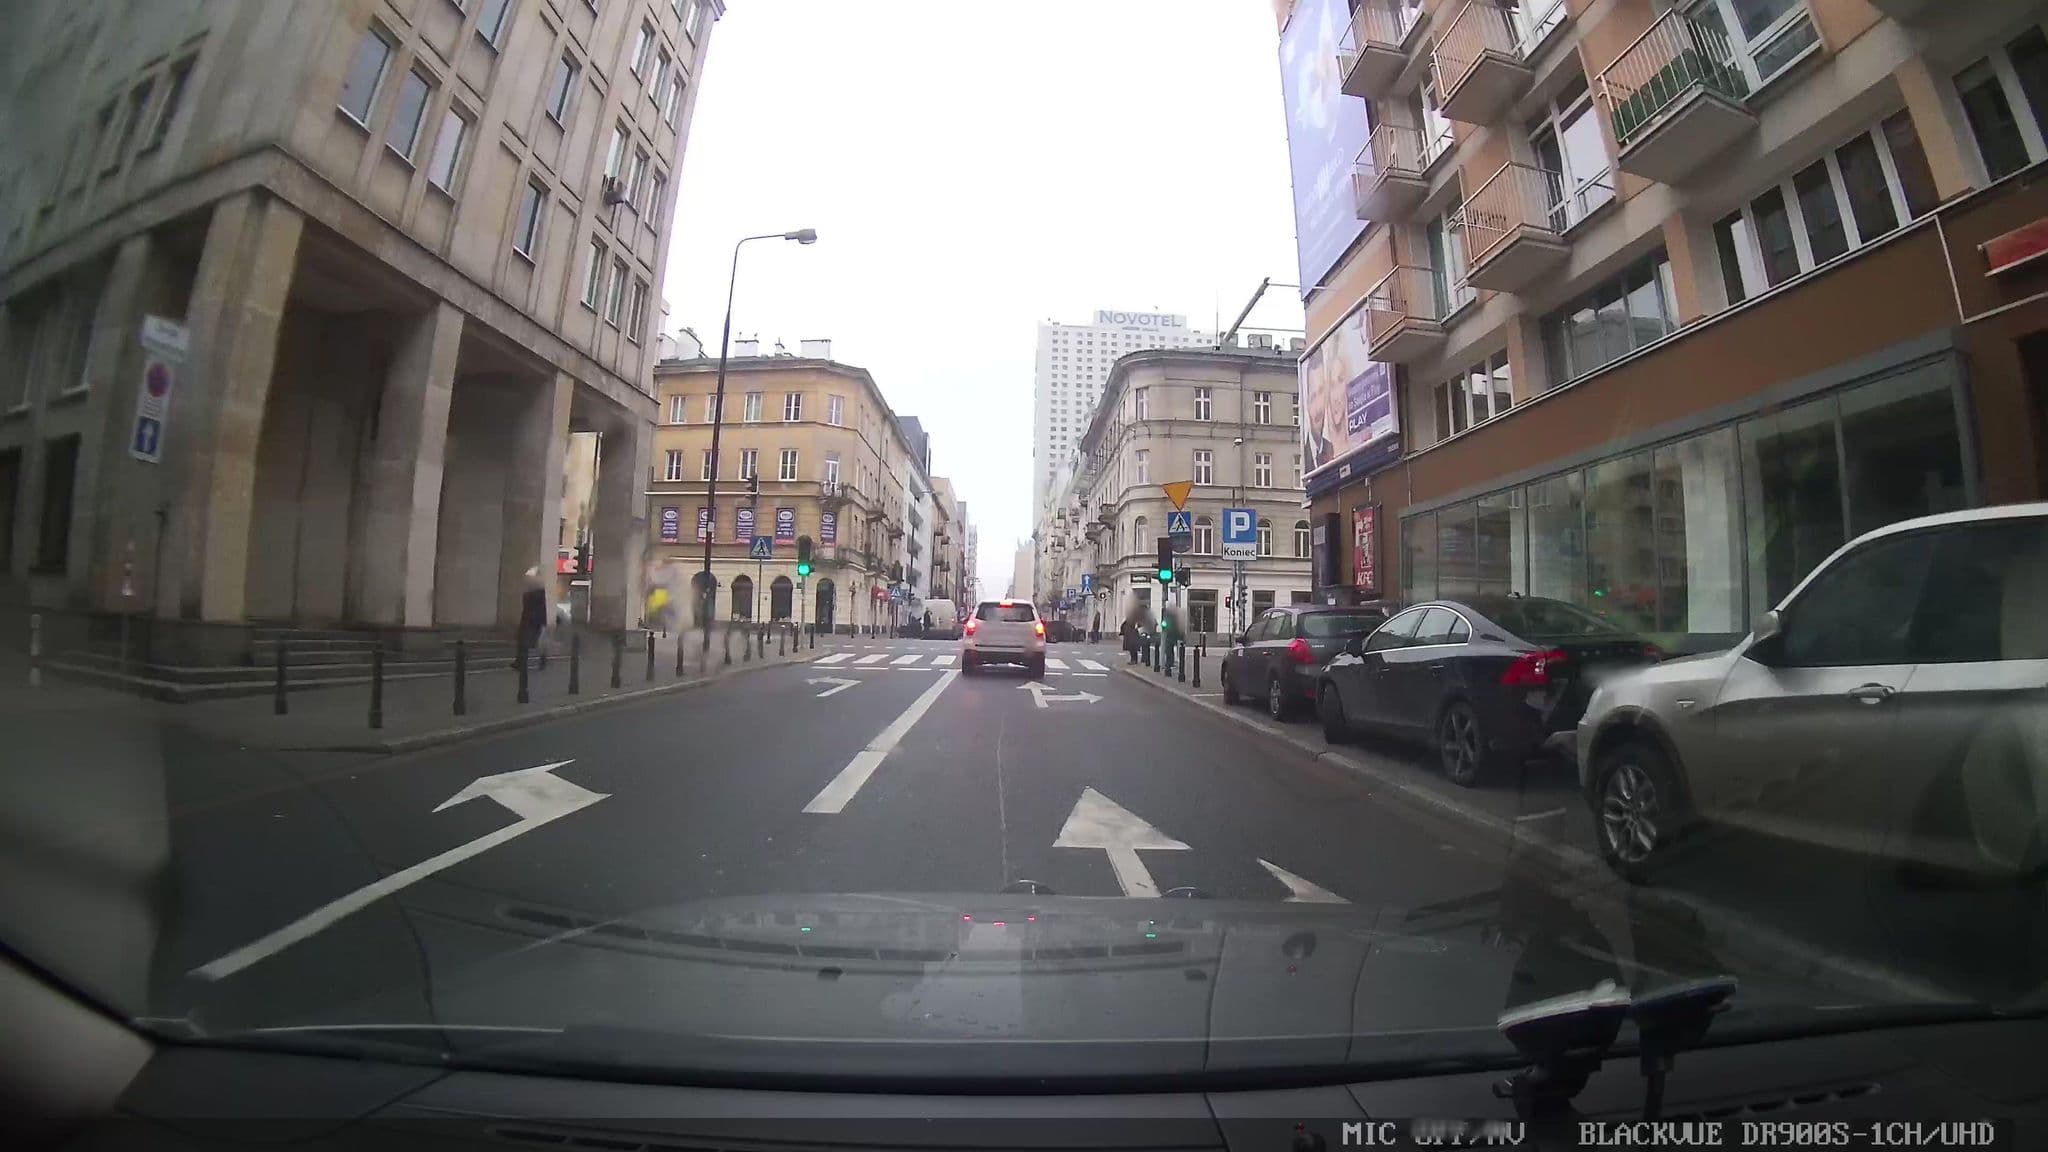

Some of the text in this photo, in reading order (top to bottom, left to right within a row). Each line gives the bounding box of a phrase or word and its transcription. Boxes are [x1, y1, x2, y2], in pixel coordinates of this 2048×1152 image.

[1099, 309, 1181, 327] NOVOTEL
[1349, 411, 1367, 431] PLAY
[1230, 511, 1250, 539] P
[1223, 546, 1256, 557] Koniec
[1357, 570, 1374, 586] KFC
